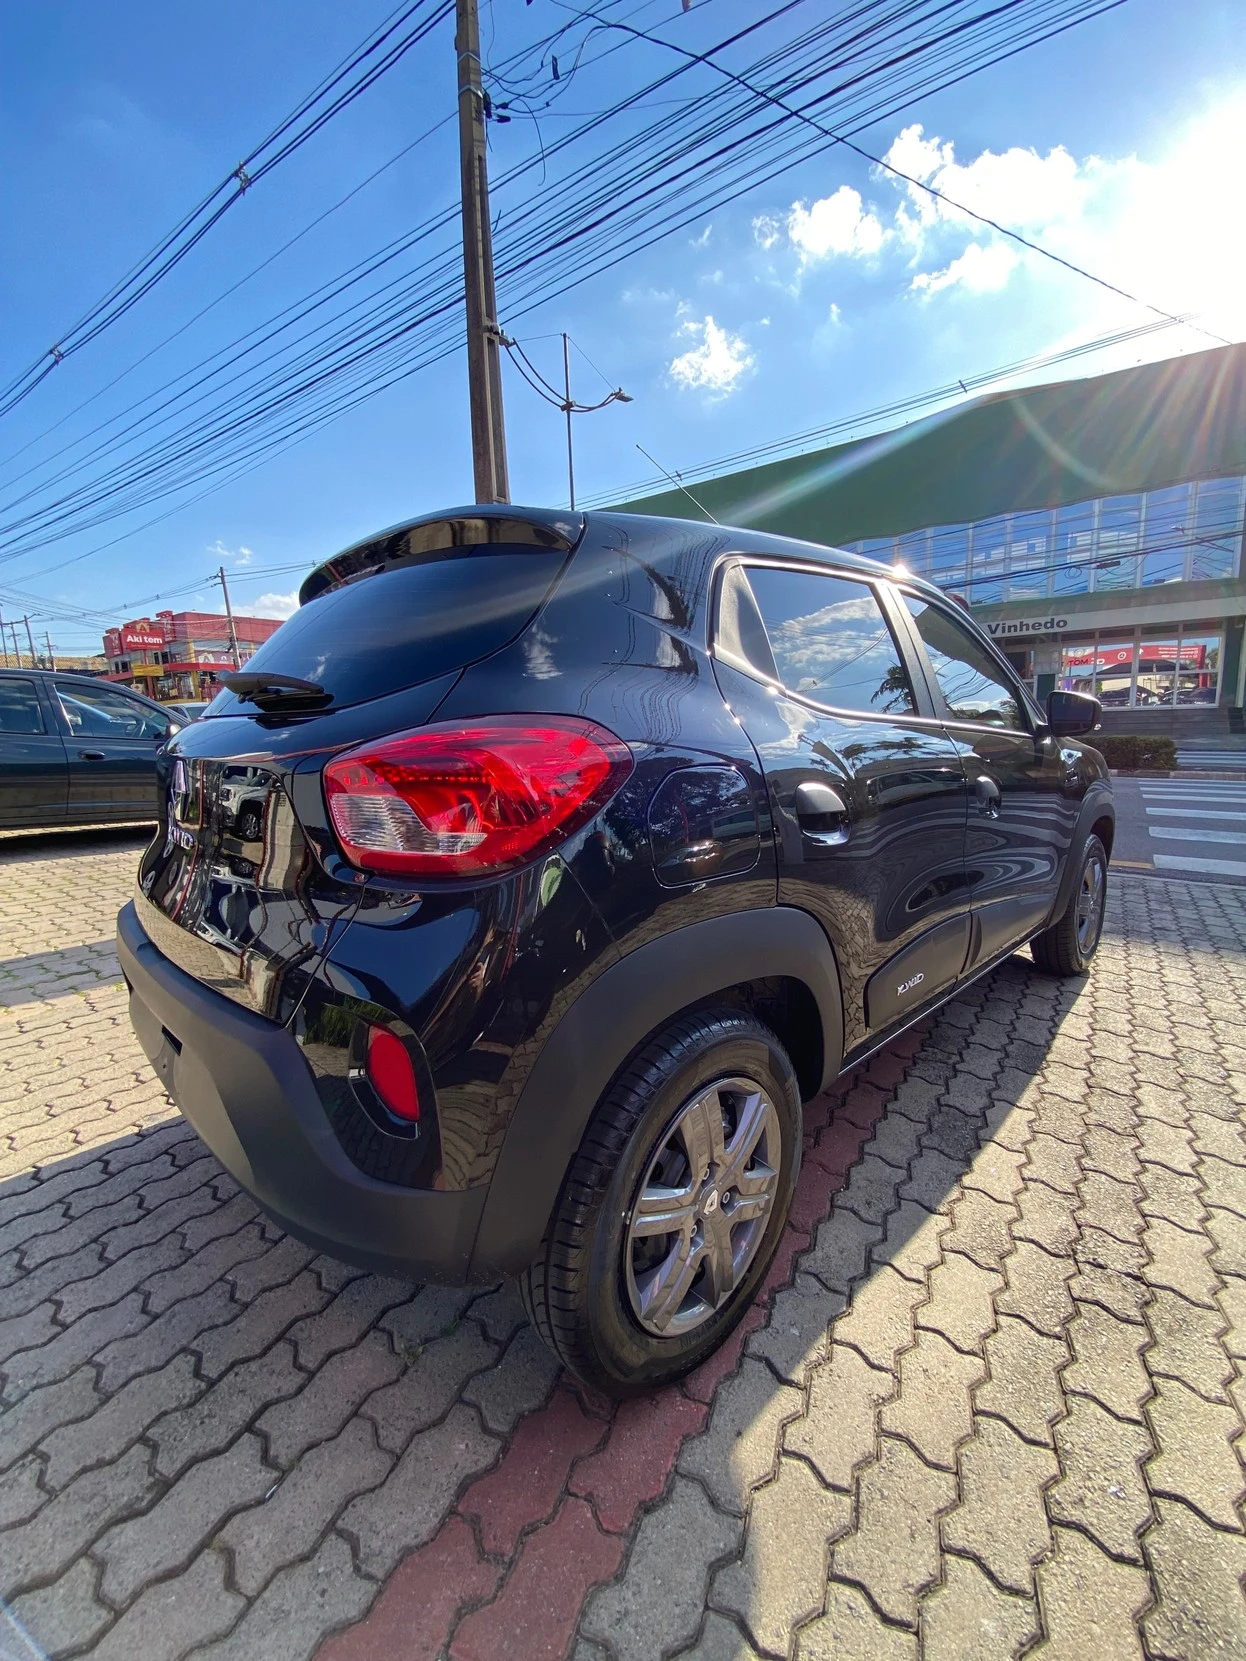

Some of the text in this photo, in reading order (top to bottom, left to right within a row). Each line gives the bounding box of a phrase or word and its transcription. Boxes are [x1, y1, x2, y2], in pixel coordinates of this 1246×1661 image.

[987, 617, 1068, 635] Vinhedo
[126, 634, 163, 644] Aki tem
[896, 972, 925, 997] KWID
